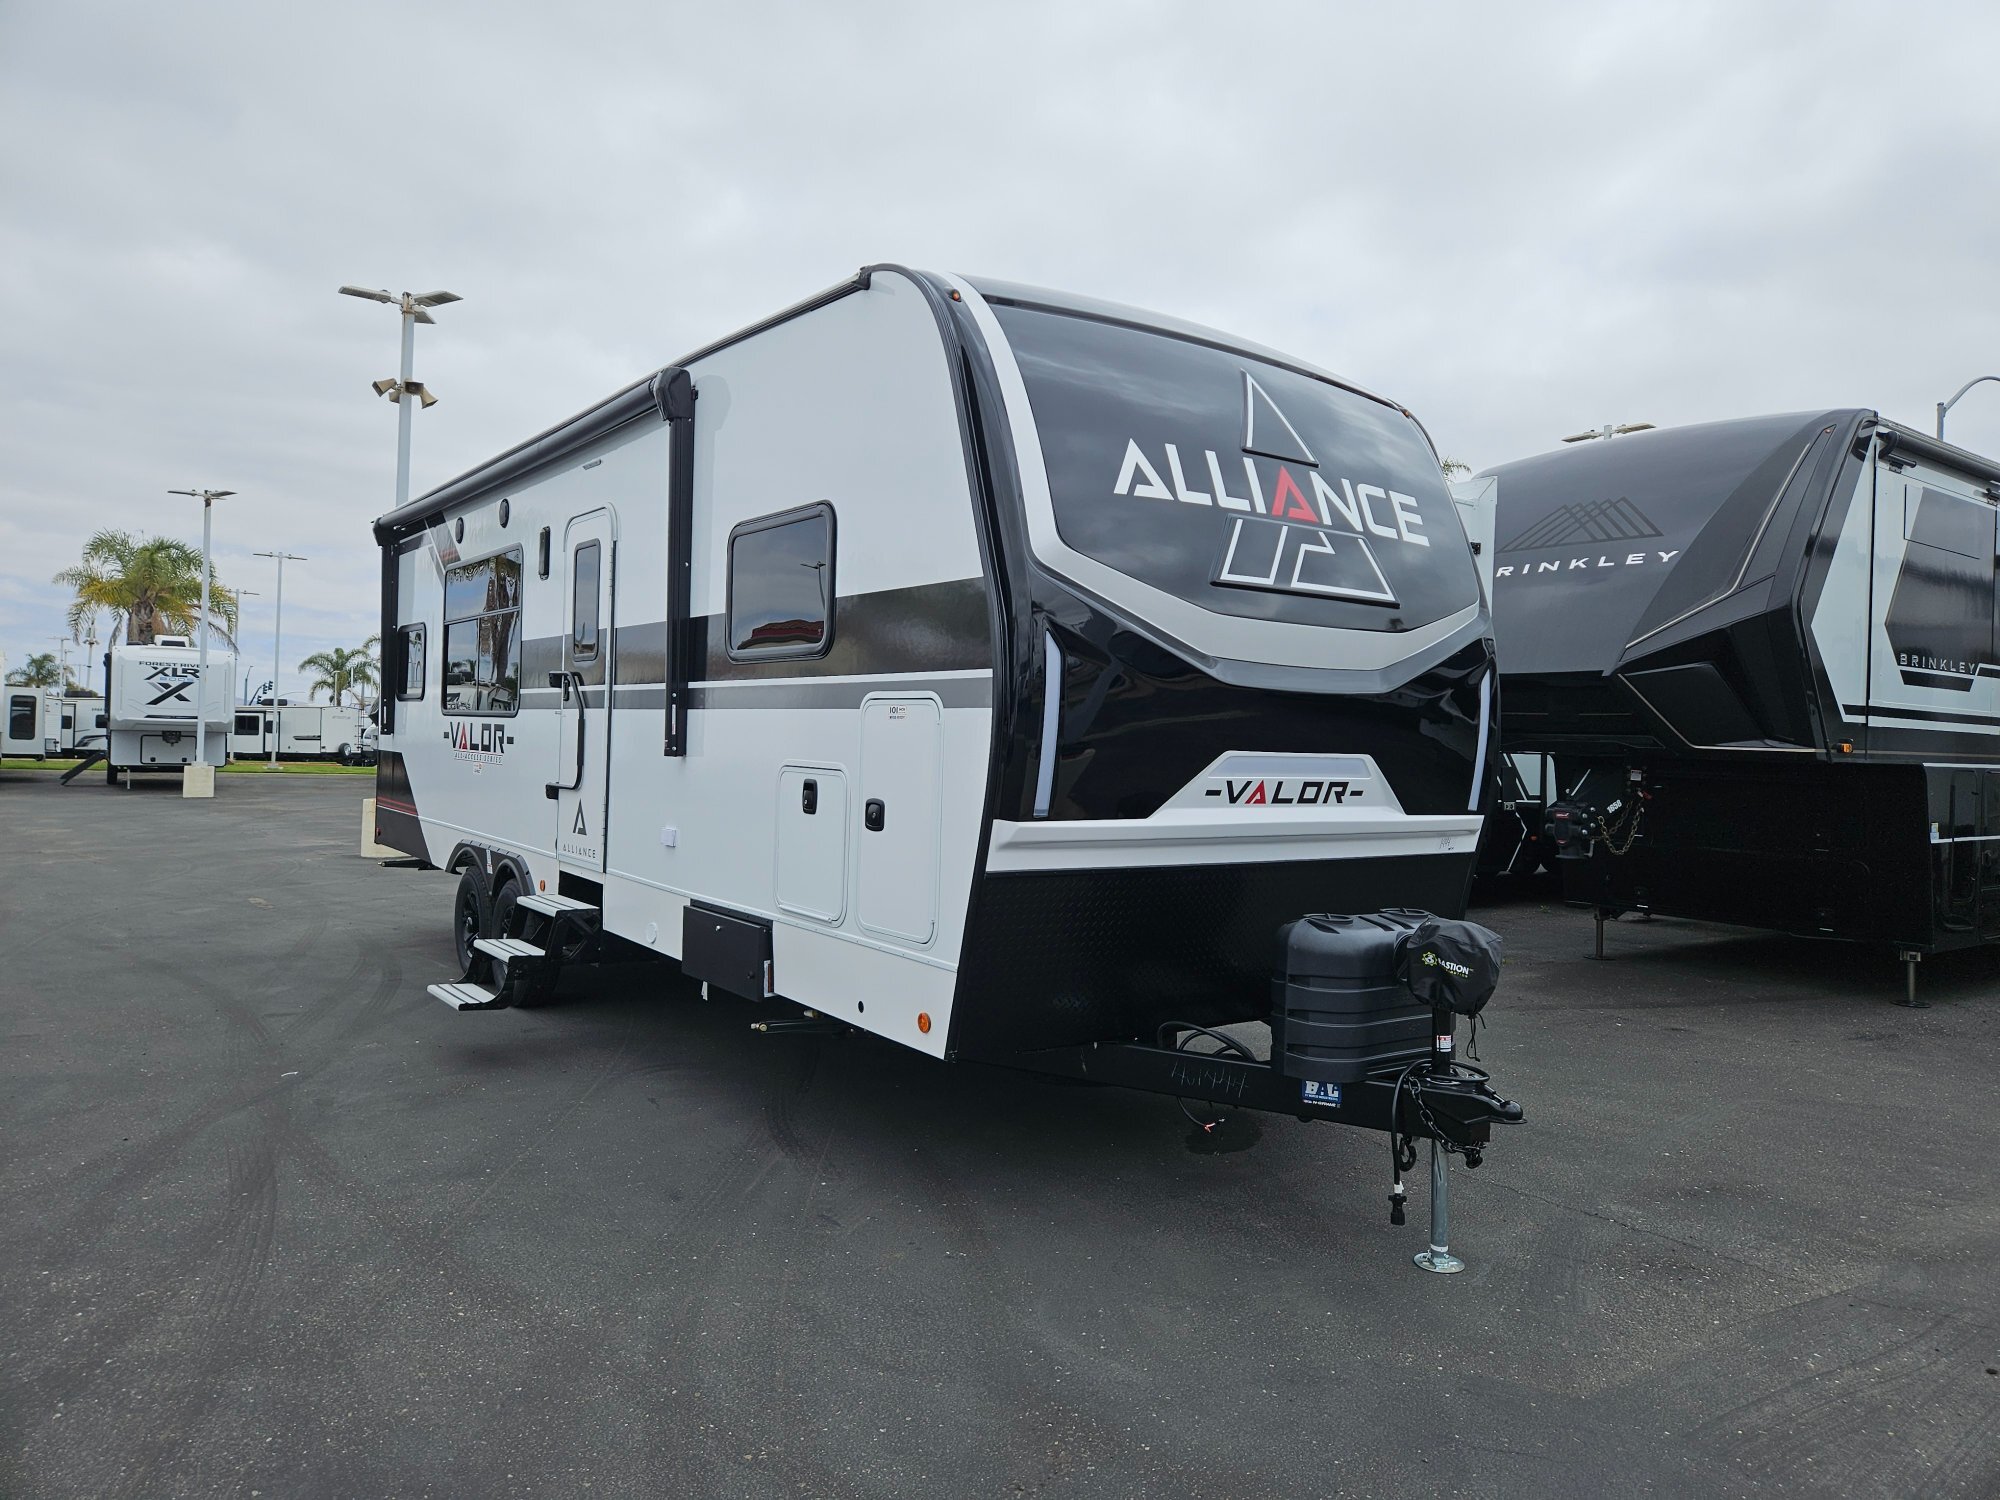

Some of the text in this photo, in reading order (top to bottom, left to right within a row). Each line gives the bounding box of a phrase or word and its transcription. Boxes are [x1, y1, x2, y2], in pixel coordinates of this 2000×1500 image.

[1113, 437, 1430, 547] ALLIANCE
[1495, 550, 1680, 577] RINKLEY
[1899, 653, 1975, 674] BRINKLEY
[144, 666, 200, 680] XLR
[1606, 799, 1623, 814] 1658
[563, 843, 596, 859] ALLIANCE
